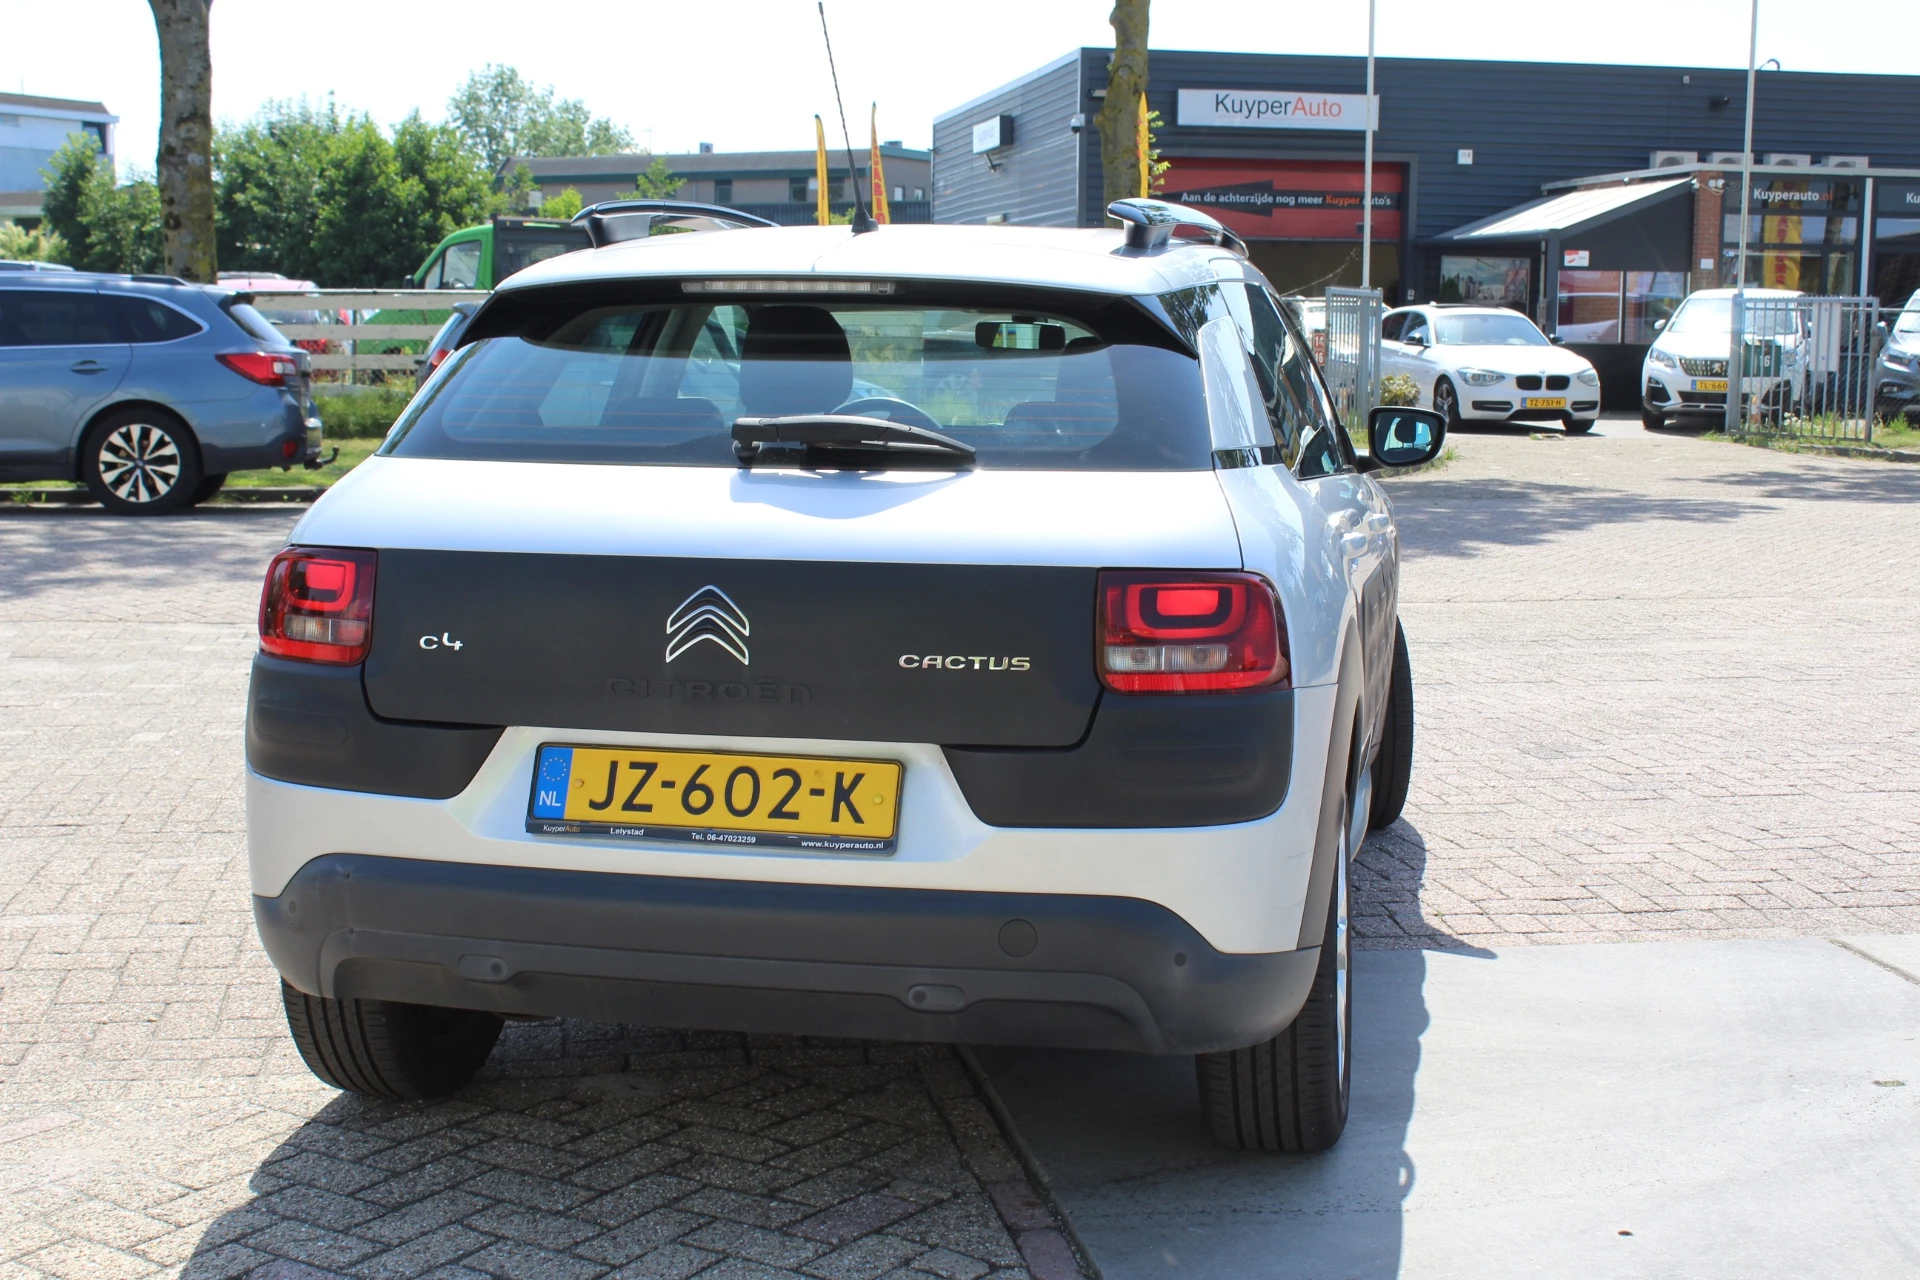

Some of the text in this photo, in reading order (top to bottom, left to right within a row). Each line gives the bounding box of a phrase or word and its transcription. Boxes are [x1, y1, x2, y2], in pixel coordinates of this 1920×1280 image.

[1215, 94, 1342, 119] KuyperAuto
[1181, 192, 1201, 202] Aan
[1204, 192, 1216, 202] de
[1218, 193, 1274, 205] achterzijde
[1276, 195, 1295, 206] nog
[1298, 196, 1323, 205] meer
[1326, 195, 1361, 206] Kuyper
[1754, 188, 1833, 202] Kuyperauto.nl
[898, 653, 1032, 672] CACTUS
[538, 790, 562, 807] NL
[588, 759, 866, 825] JZ-602-K
[543, 824, 581, 833] KuyperAuto
[610, 827, 645, 836] Lelystad
[691, 832, 756, 843] Tel. 06-47023259
[801, 840, 884, 849] www.kuyperauto.nl
